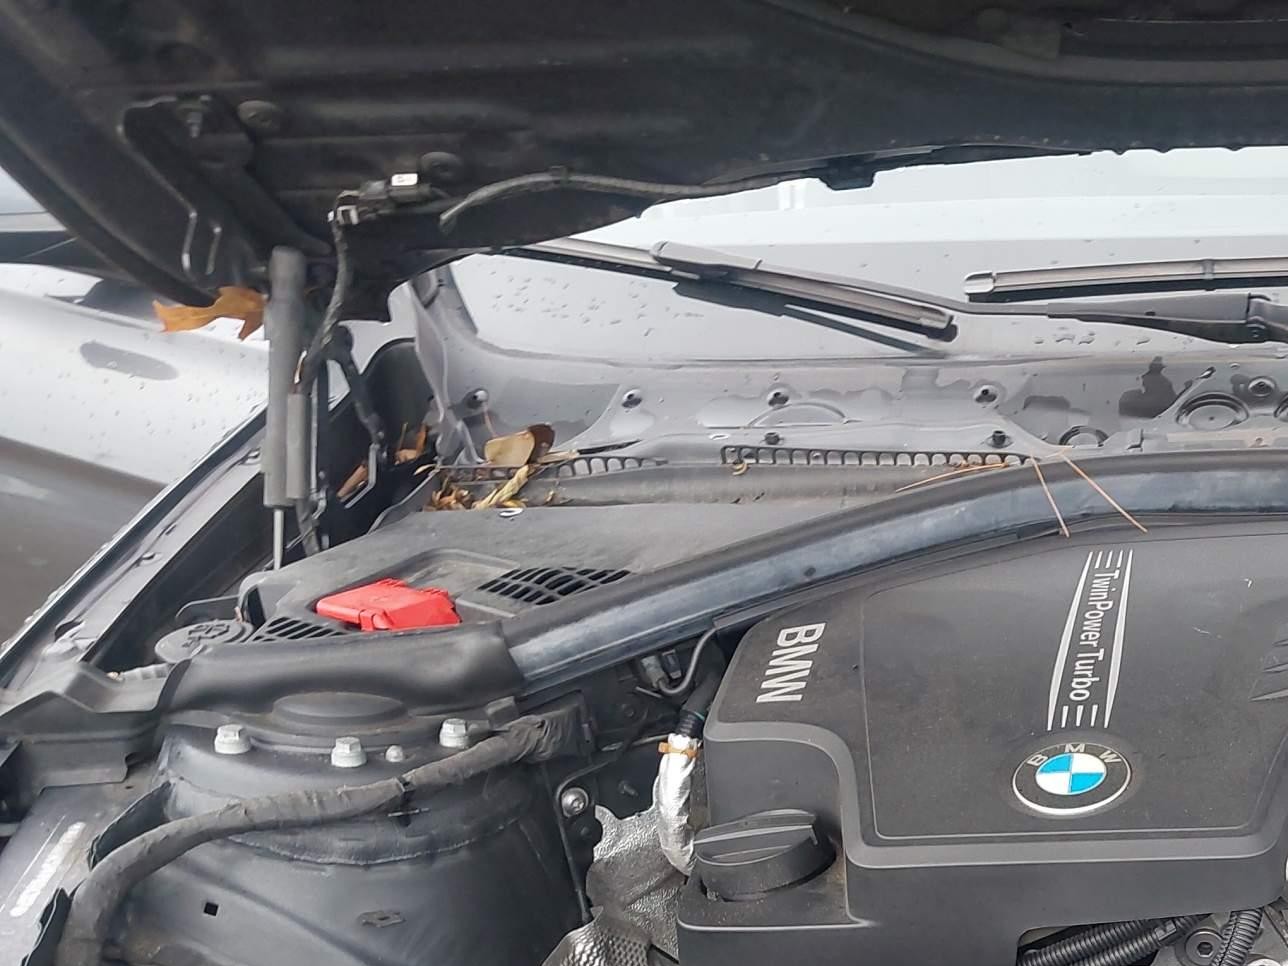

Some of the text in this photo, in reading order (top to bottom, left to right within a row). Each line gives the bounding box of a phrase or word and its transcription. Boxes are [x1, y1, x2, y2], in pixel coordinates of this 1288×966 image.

[756, 622, 826, 703] BMW
[1068, 568, 1120, 701] TwinPower Turbo
[1026, 743, 1121, 767] BMW
